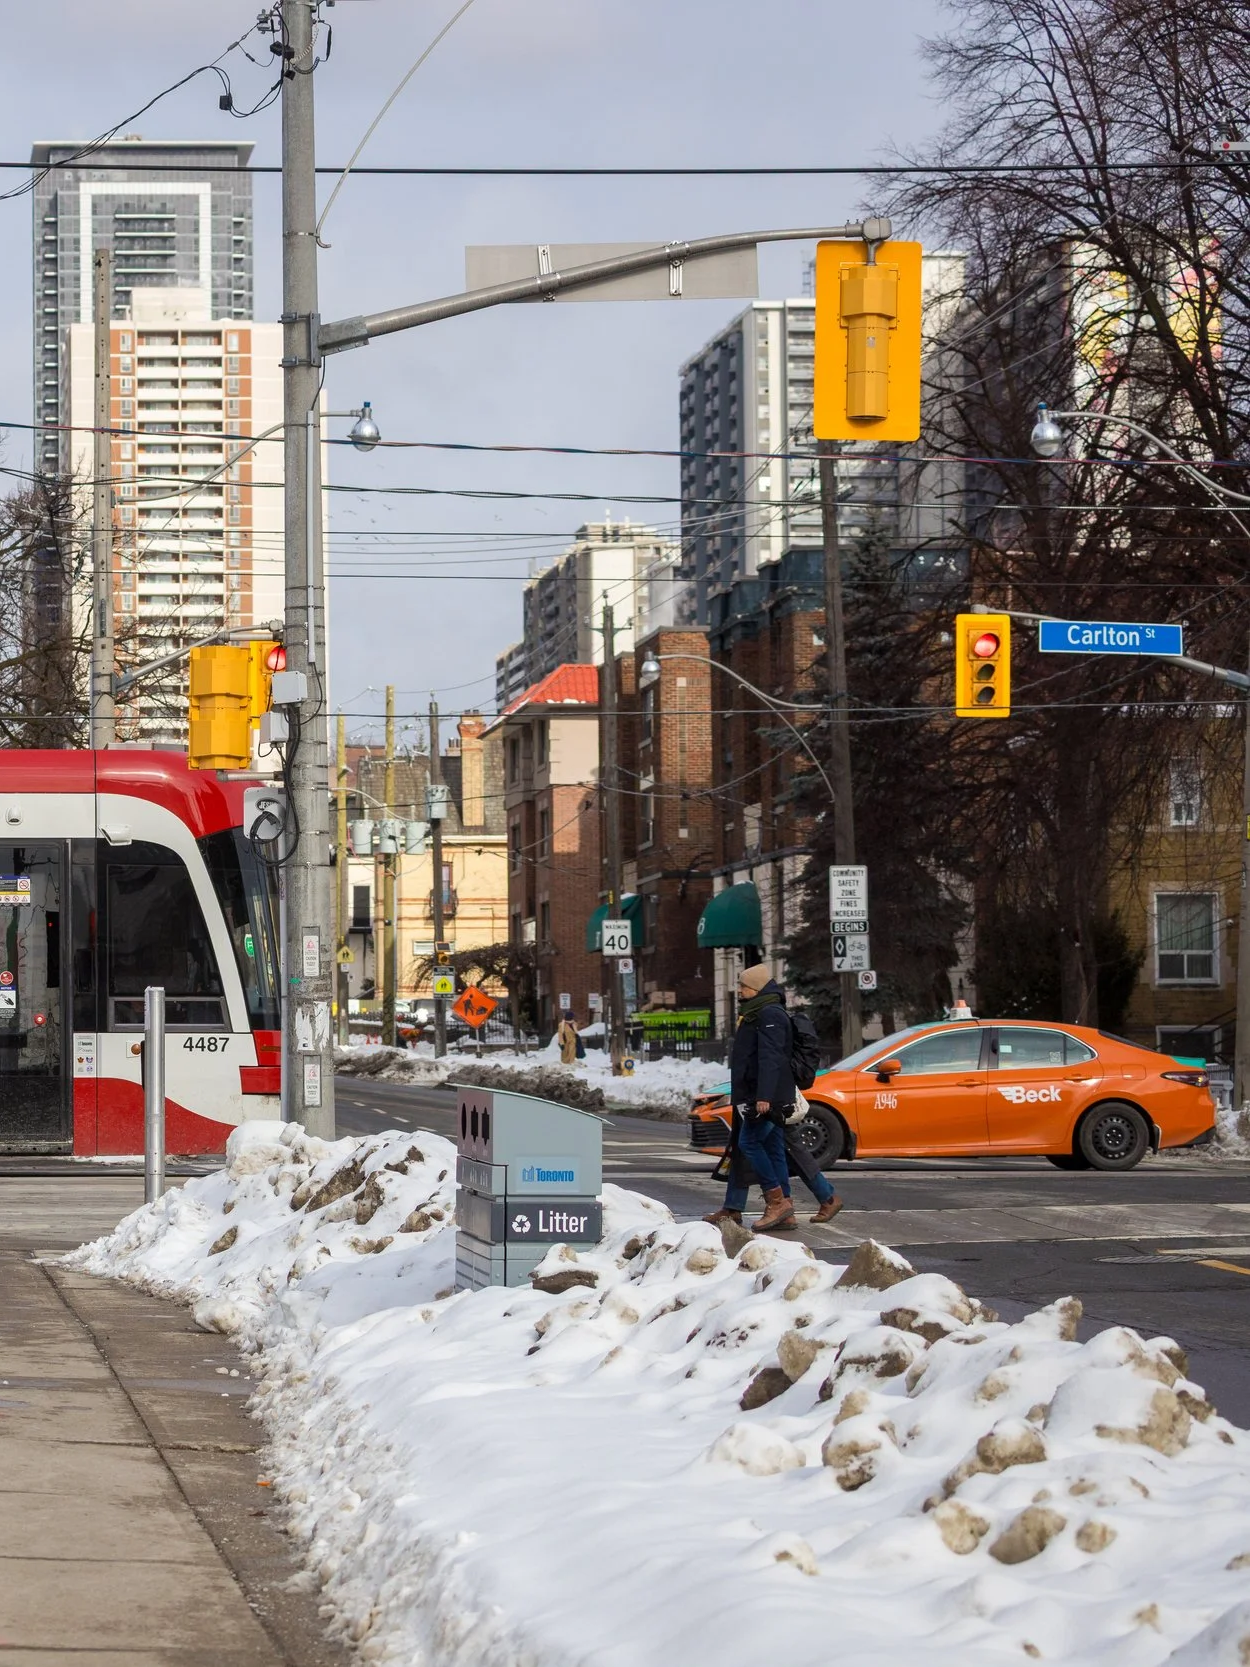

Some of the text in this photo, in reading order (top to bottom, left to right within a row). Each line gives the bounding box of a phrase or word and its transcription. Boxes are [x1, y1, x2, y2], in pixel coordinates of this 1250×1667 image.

[1067, 625, 1155, 646] Carlton St
[833, 869, 864, 877] COMMUNITY
[833, 909, 866, 917] INCREASED
[834, 923, 865, 932] BEGINS
[605, 935, 629, 950] 40
[183, 1036, 230, 1052] 4487
[874, 1093, 898, 1110] A946
[1012, 1086, 1062, 1104] Beck
[536, 1168, 575, 1182] TORONTO
[538, 1210, 588, 1233] Litter
